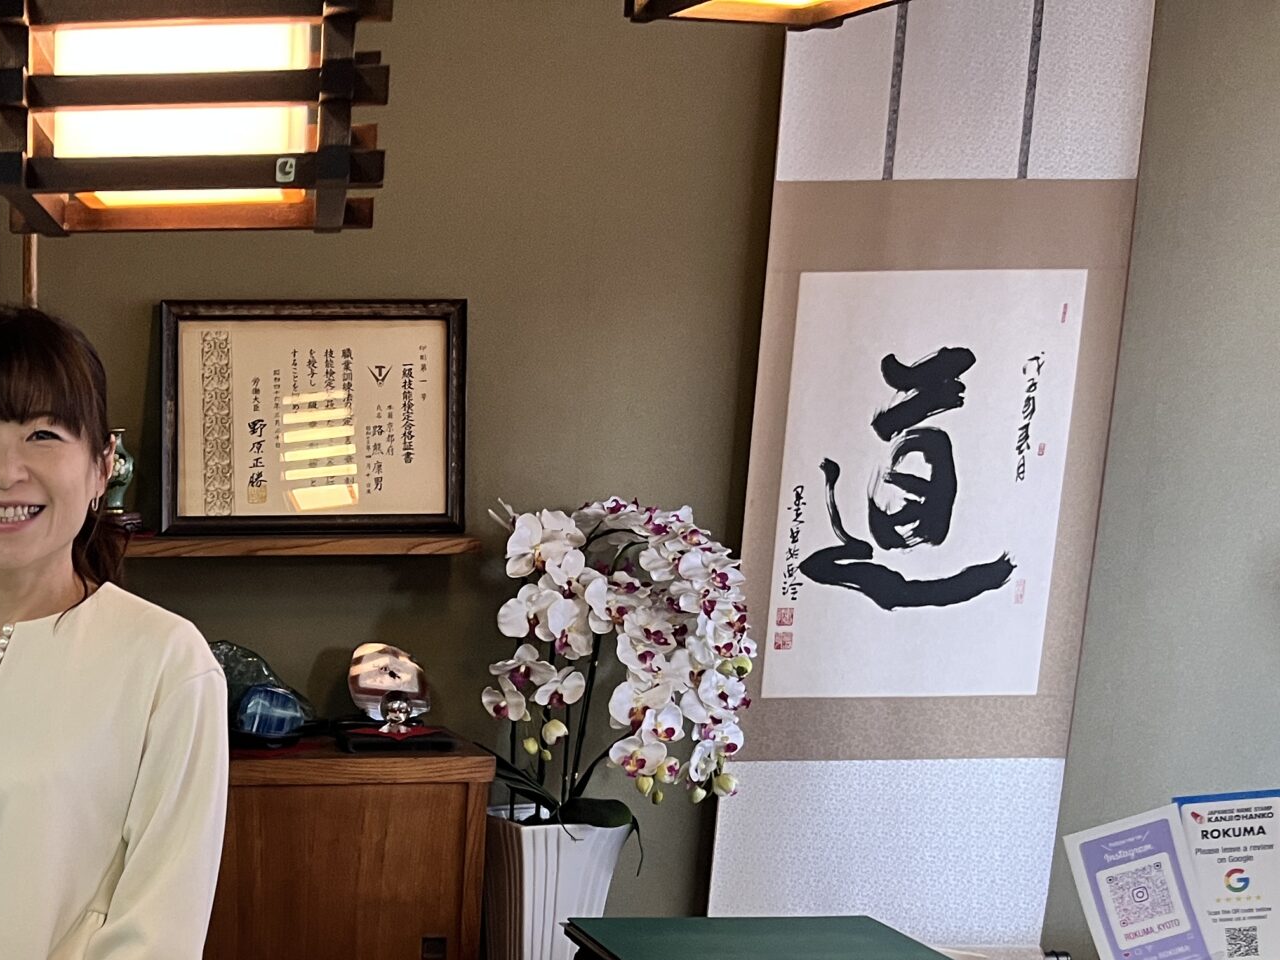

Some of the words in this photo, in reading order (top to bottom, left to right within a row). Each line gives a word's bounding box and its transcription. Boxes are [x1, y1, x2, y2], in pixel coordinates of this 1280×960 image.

[401, 363, 415, 464] 一級技能検定合格証書
[799, 346, 1017, 612] 道
[1241, 812, 1274, 821] HANKO
[1201, 825, 1267, 840] ROKUMA
[1104, 843, 1154, 864] Instagram
[1195, 846, 1220, 856] Please
[1221, 845, 1241, 854] leave
[1249, 843, 1275, 852] review
[1217, 856, 1226, 864] on
[1228, 854, 1254, 864] Google
[1123, 919, 1181, 942] ROKUMA_KYOTO
